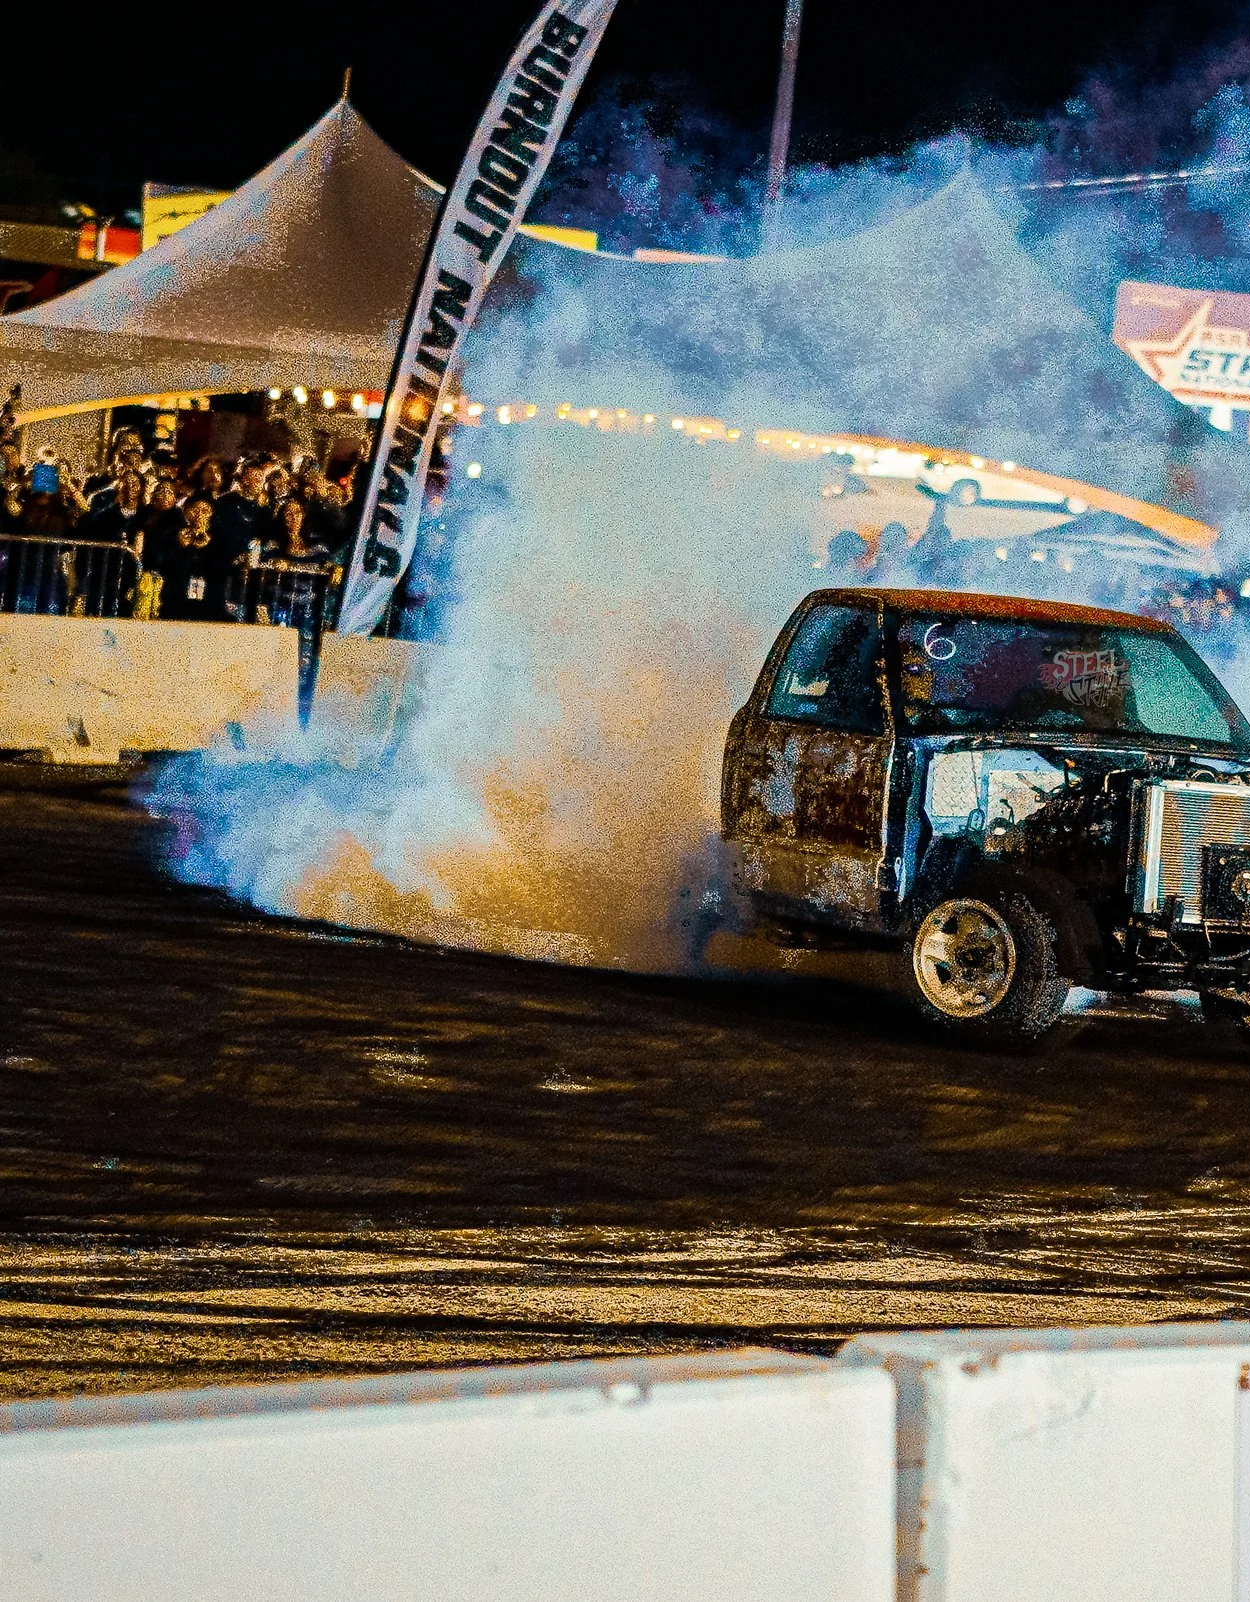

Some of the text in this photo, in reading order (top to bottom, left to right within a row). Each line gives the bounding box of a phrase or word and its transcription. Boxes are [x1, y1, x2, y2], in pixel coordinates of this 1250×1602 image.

[362, 9, 588, 579] BURNOUT NATIONALS
[924, 622, 957, 660] 6
[1053, 648, 1128, 680] STEEL
